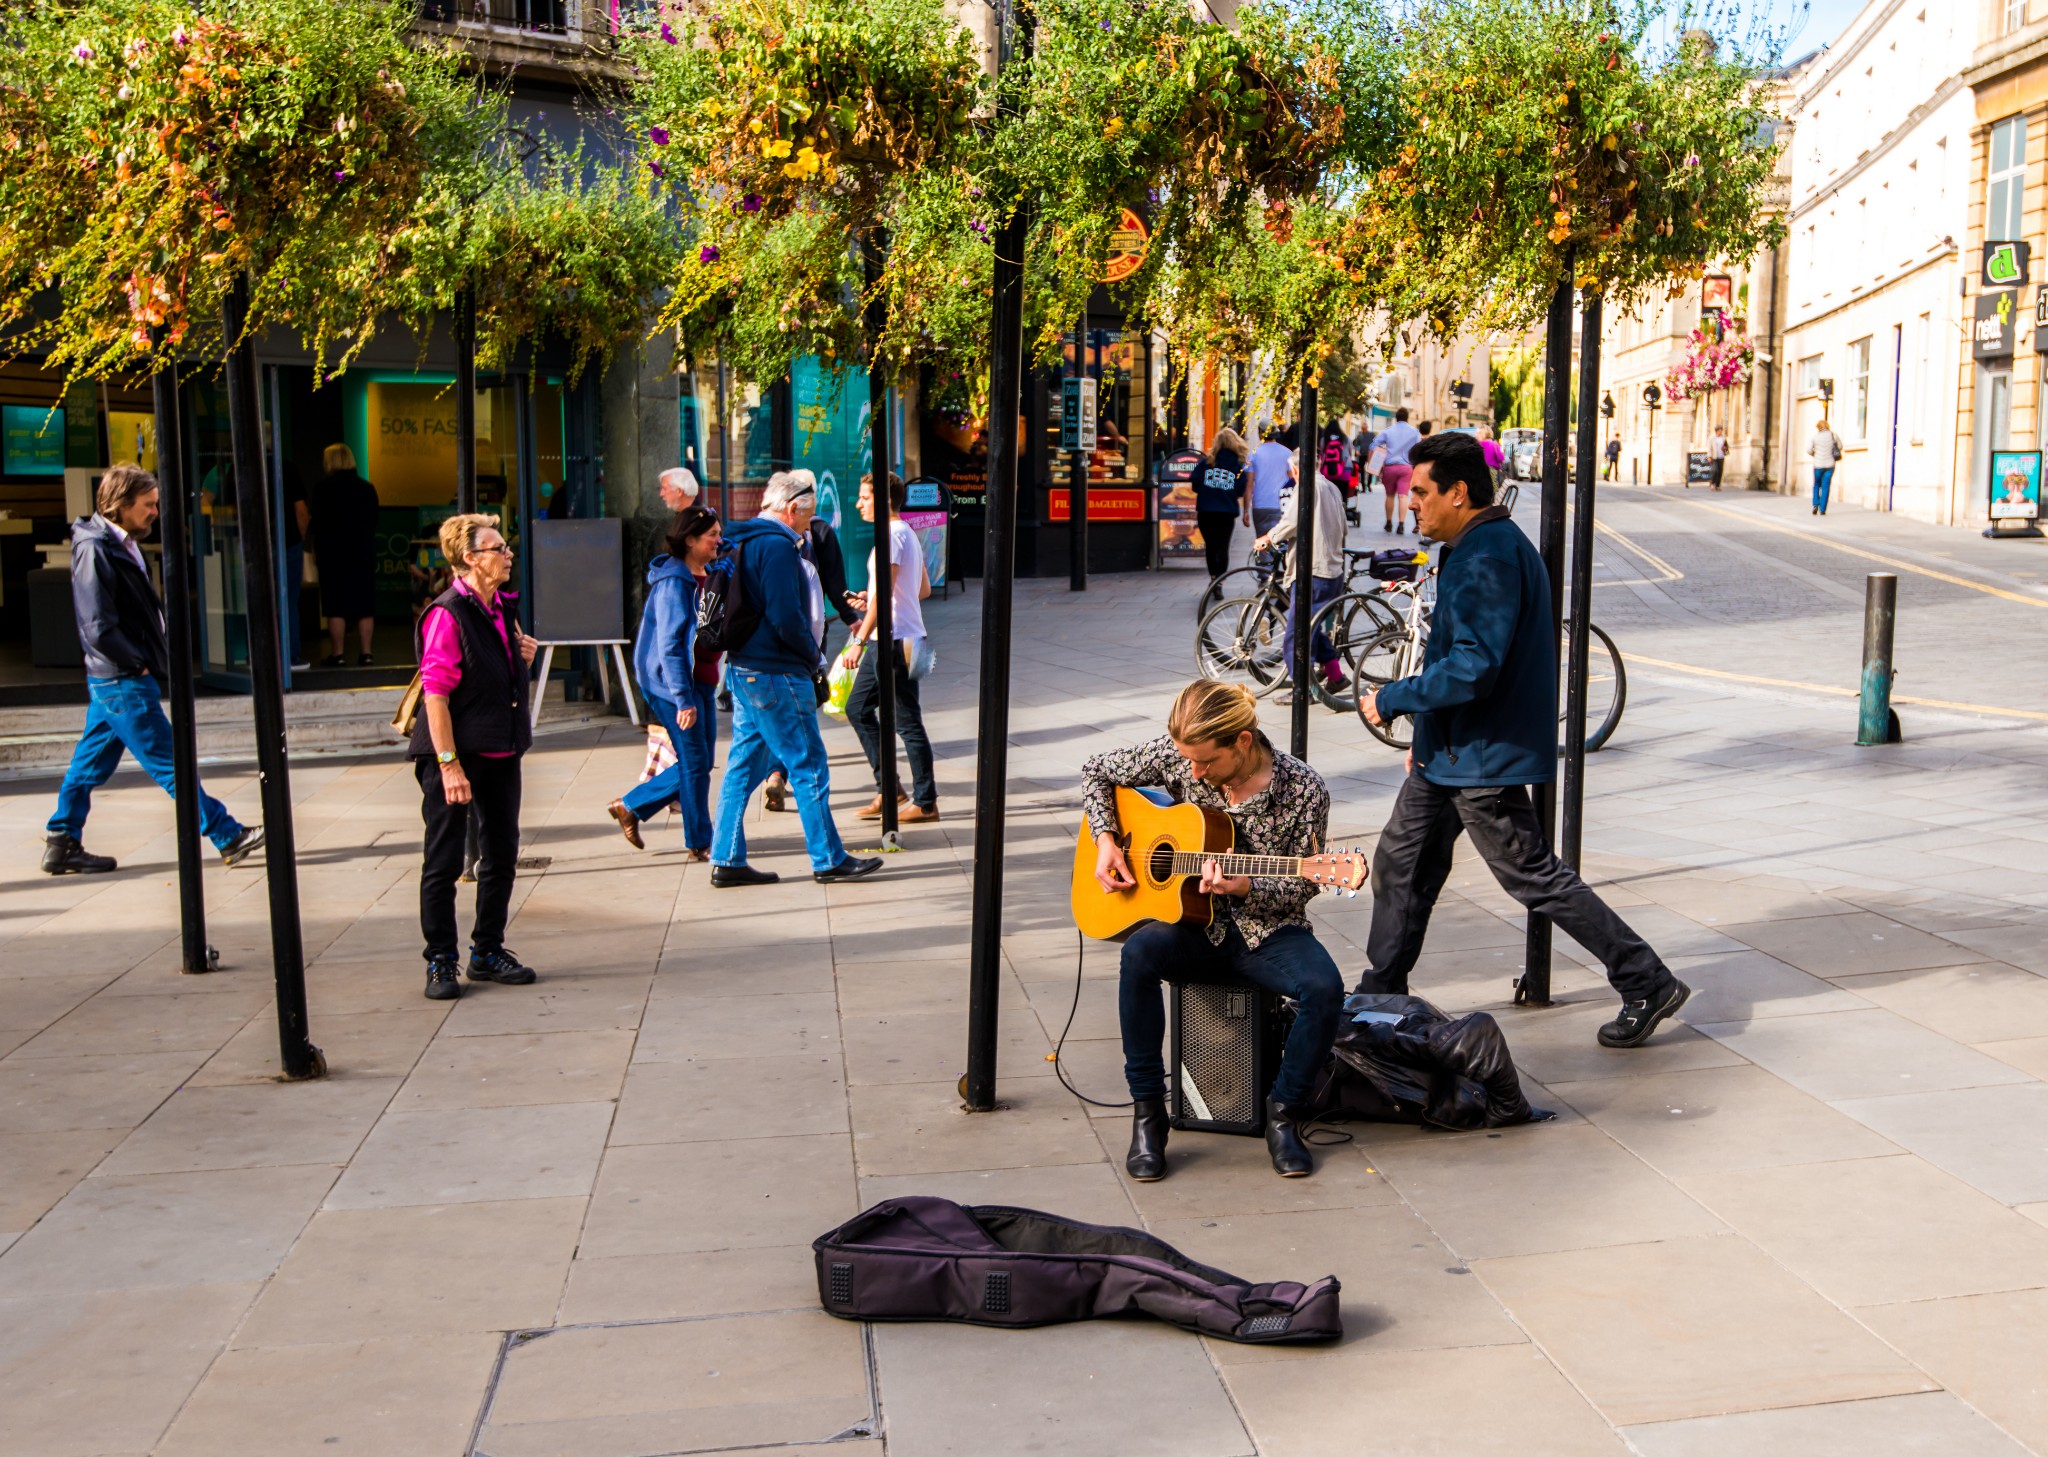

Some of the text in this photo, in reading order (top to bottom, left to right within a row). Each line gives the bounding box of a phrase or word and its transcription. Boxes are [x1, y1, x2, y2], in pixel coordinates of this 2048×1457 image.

[1107, 257, 1134, 276] OUSE
[381, 417, 495, 436] 50% FASER
[950, 472, 980, 483] Freshly
[1204, 468, 1236, 483] PEER
[1204, 479, 1235, 491] MENTOR
[952, 494, 977, 505] From
[1088, 499, 1140, 509] BAGUETTES
[904, 512, 942, 524] NISEX HAIR
[912, 519, 938, 530] BEAUTY
